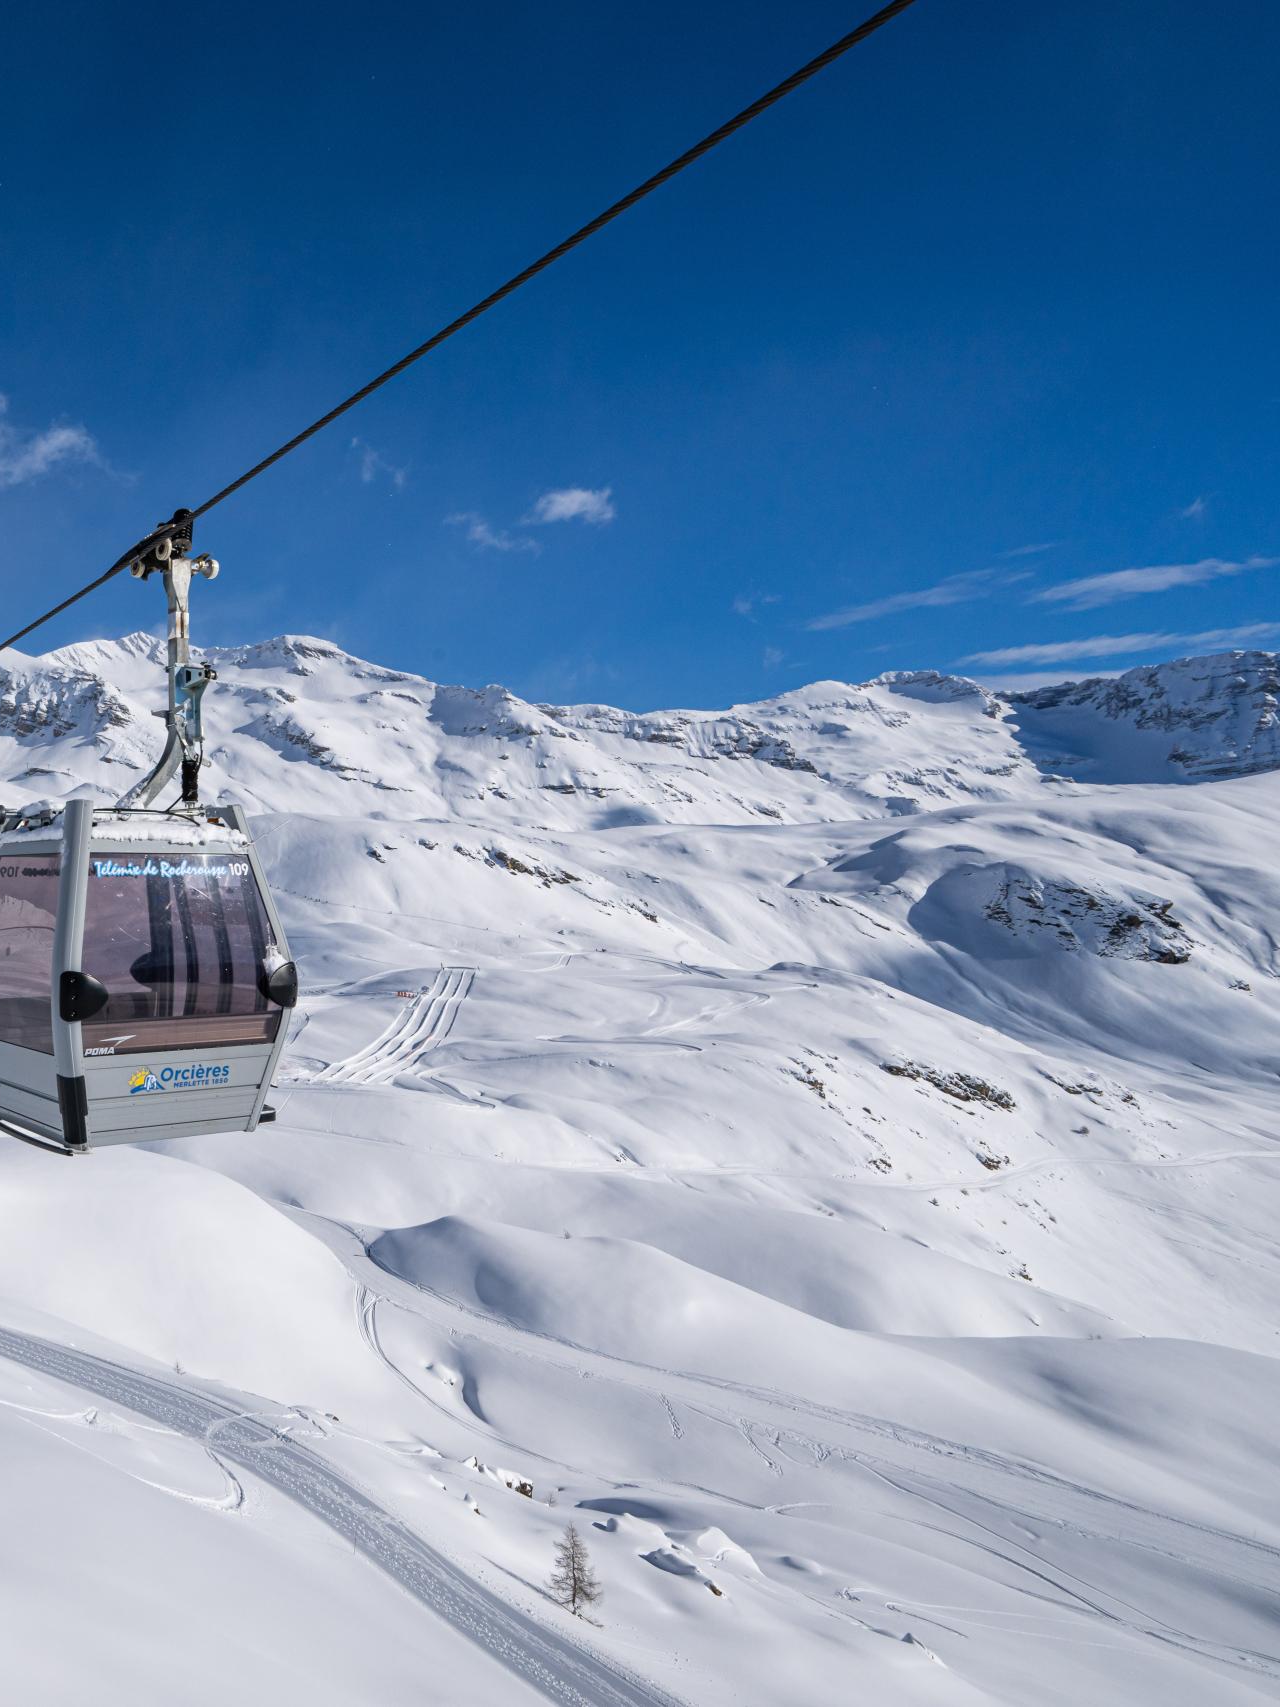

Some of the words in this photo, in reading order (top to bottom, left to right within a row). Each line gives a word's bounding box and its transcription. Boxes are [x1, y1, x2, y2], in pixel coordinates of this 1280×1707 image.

[142, 860, 159, 875] de
[229, 862, 249, 875] 109
[85, 1047, 115, 1056] POMA
[161, 1064, 229, 1081] Orcières
[174, 1079, 210, 1088] MERLETTE
